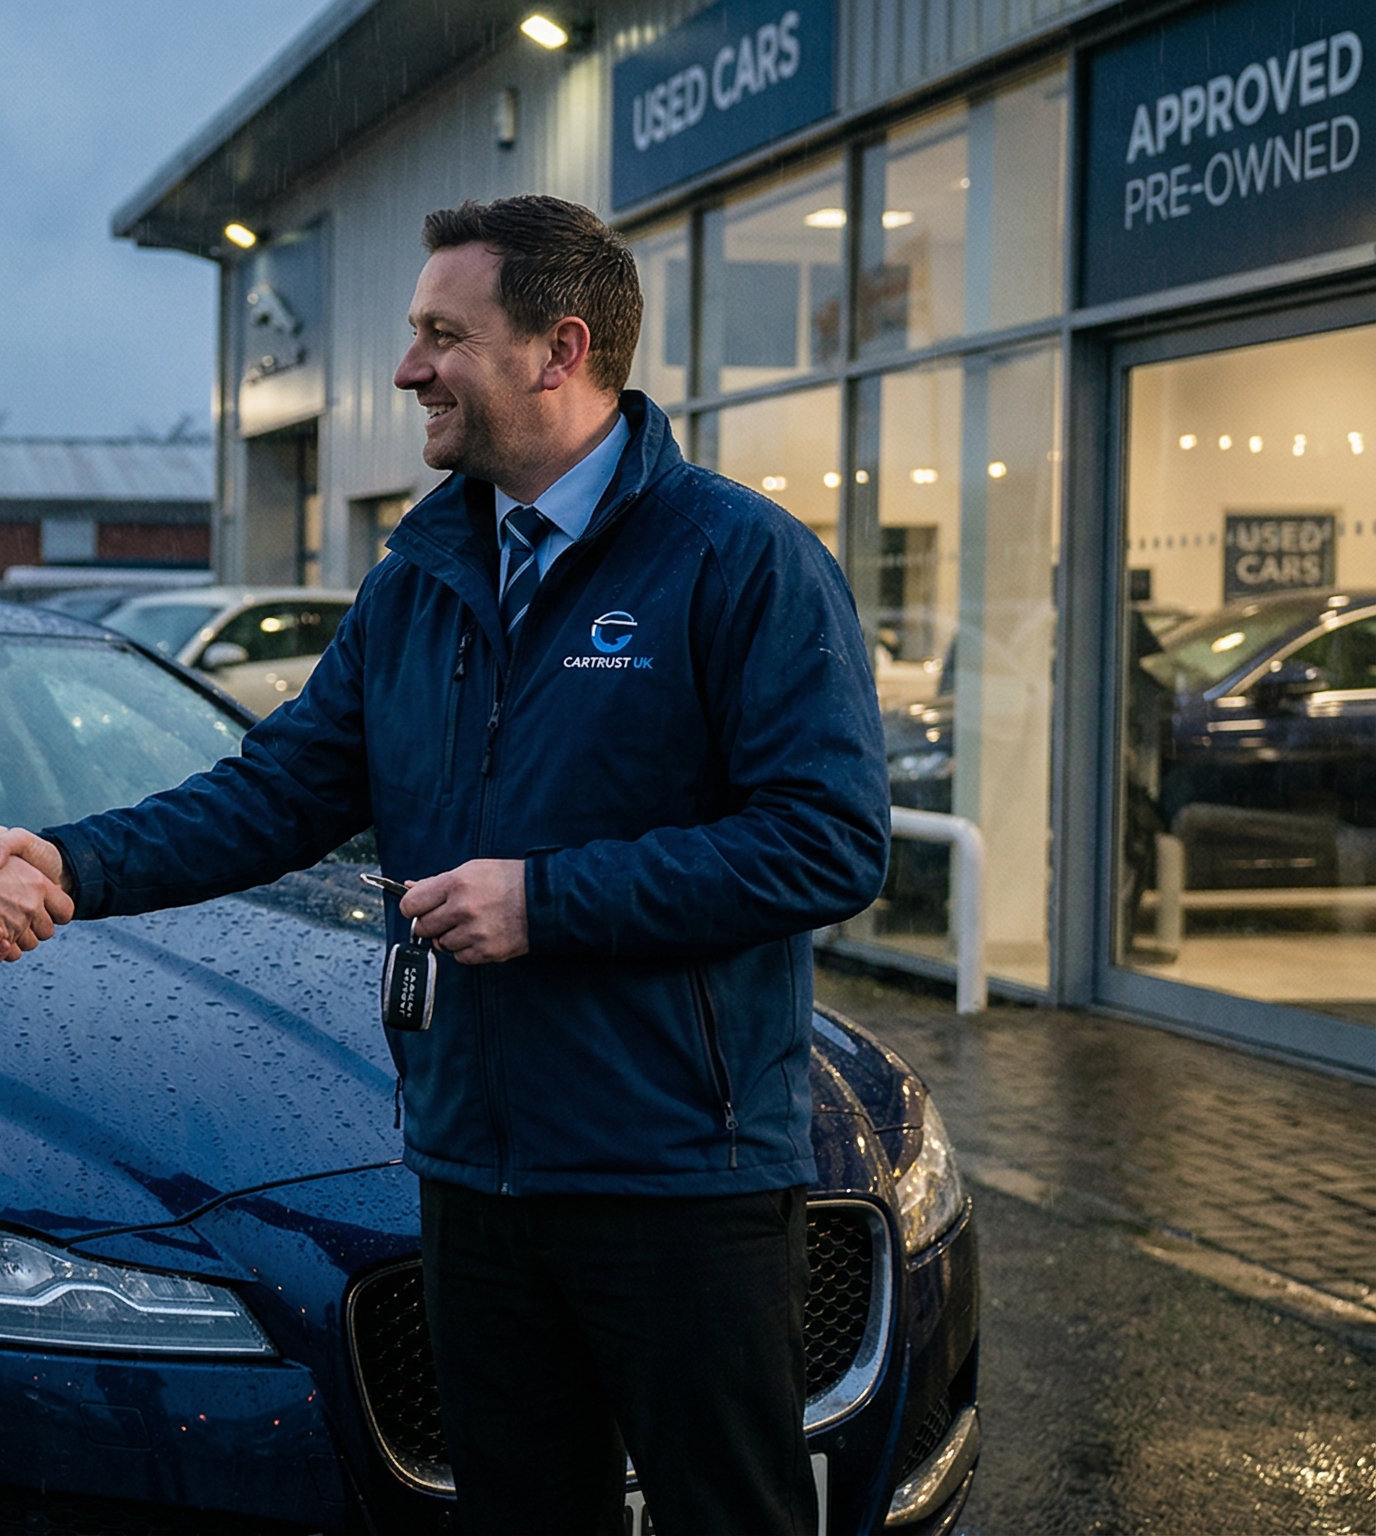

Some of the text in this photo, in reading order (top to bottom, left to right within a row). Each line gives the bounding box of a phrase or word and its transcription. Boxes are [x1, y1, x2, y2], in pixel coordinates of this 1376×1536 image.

[633, 10, 800, 151] USED CARS
[1126, 30, 1363, 164] APPROVED
[1125, 115, 1360, 230] PRE-OWNED
[1236, 521, 1322, 552] USED
[1236, 553, 1321, 585] CARS
[563, 656, 654, 670] CARTRUST UK
